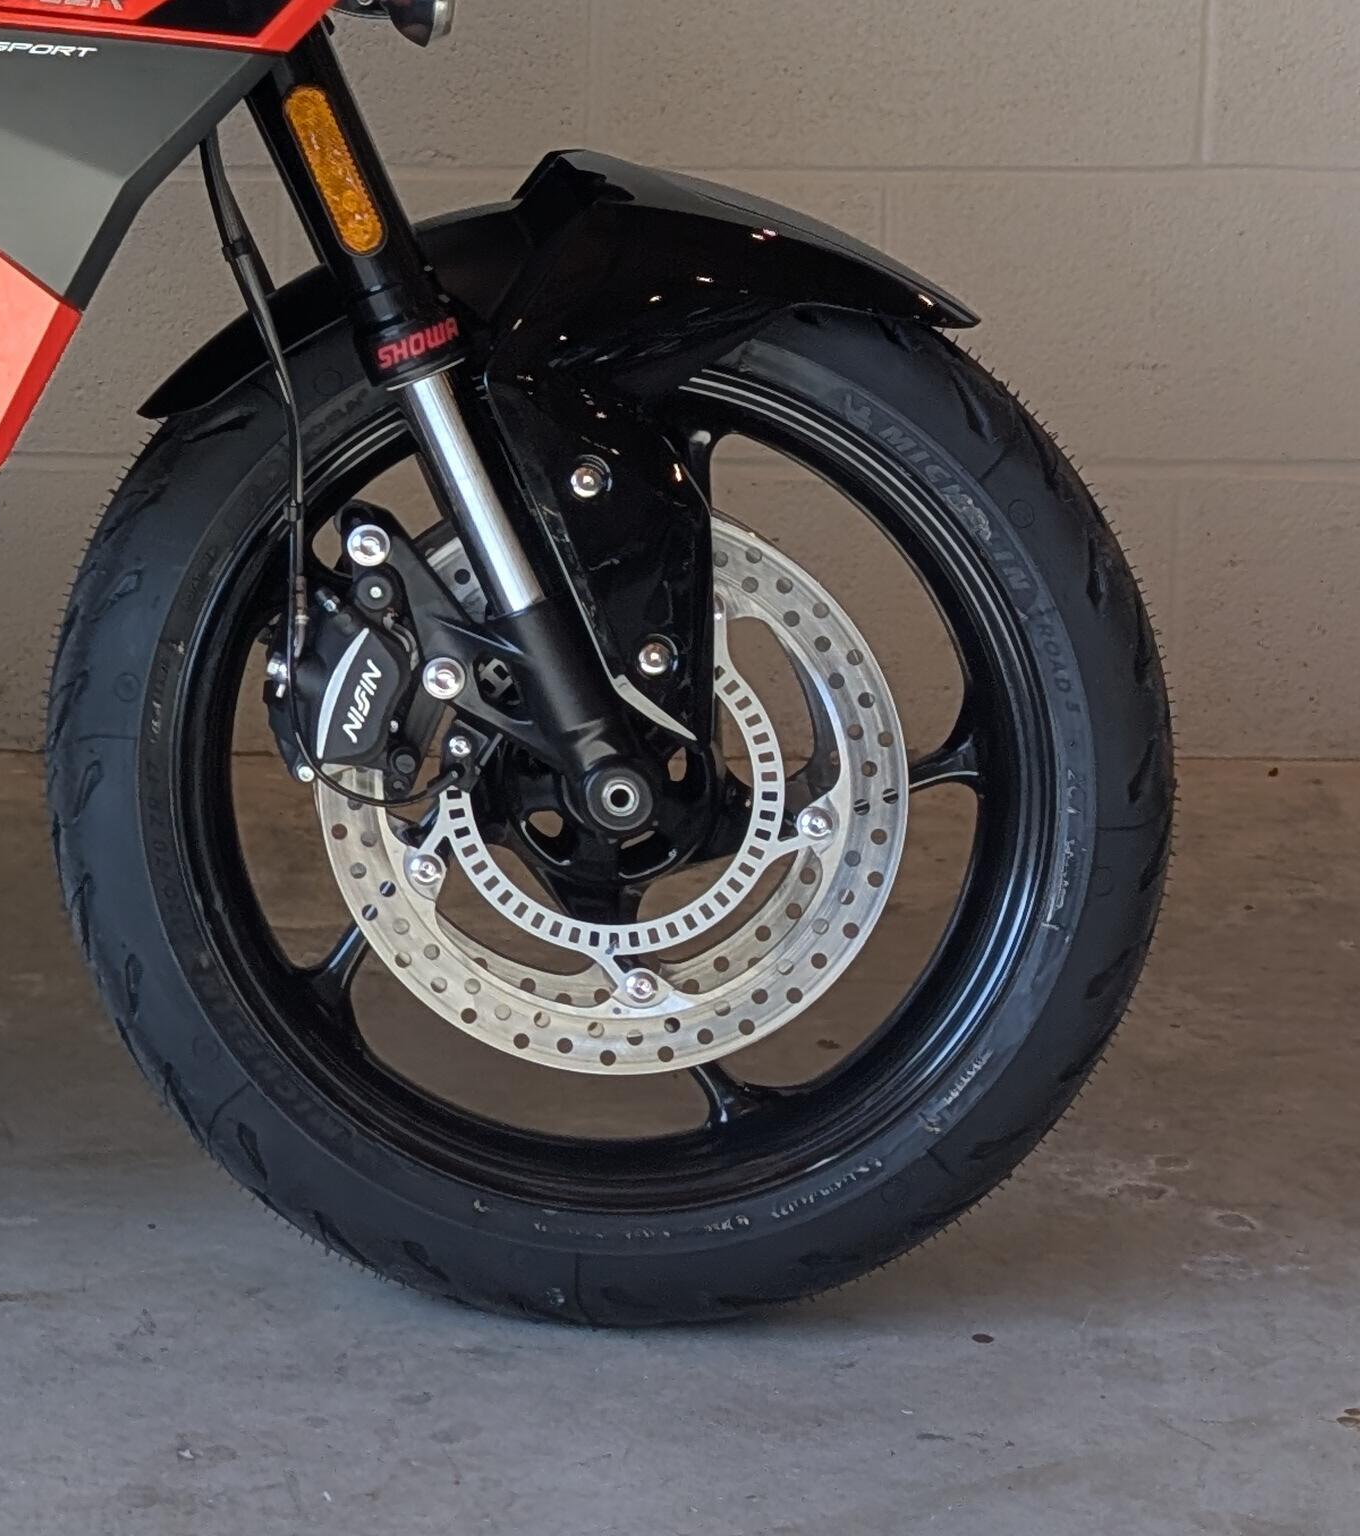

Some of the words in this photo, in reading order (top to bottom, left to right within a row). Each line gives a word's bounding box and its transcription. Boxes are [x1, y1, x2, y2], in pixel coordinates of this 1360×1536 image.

[376, 316, 460, 370] SHOWA
[878, 425, 1032, 591] MICLIN
[1036, 622, 1073, 693] ROAD
